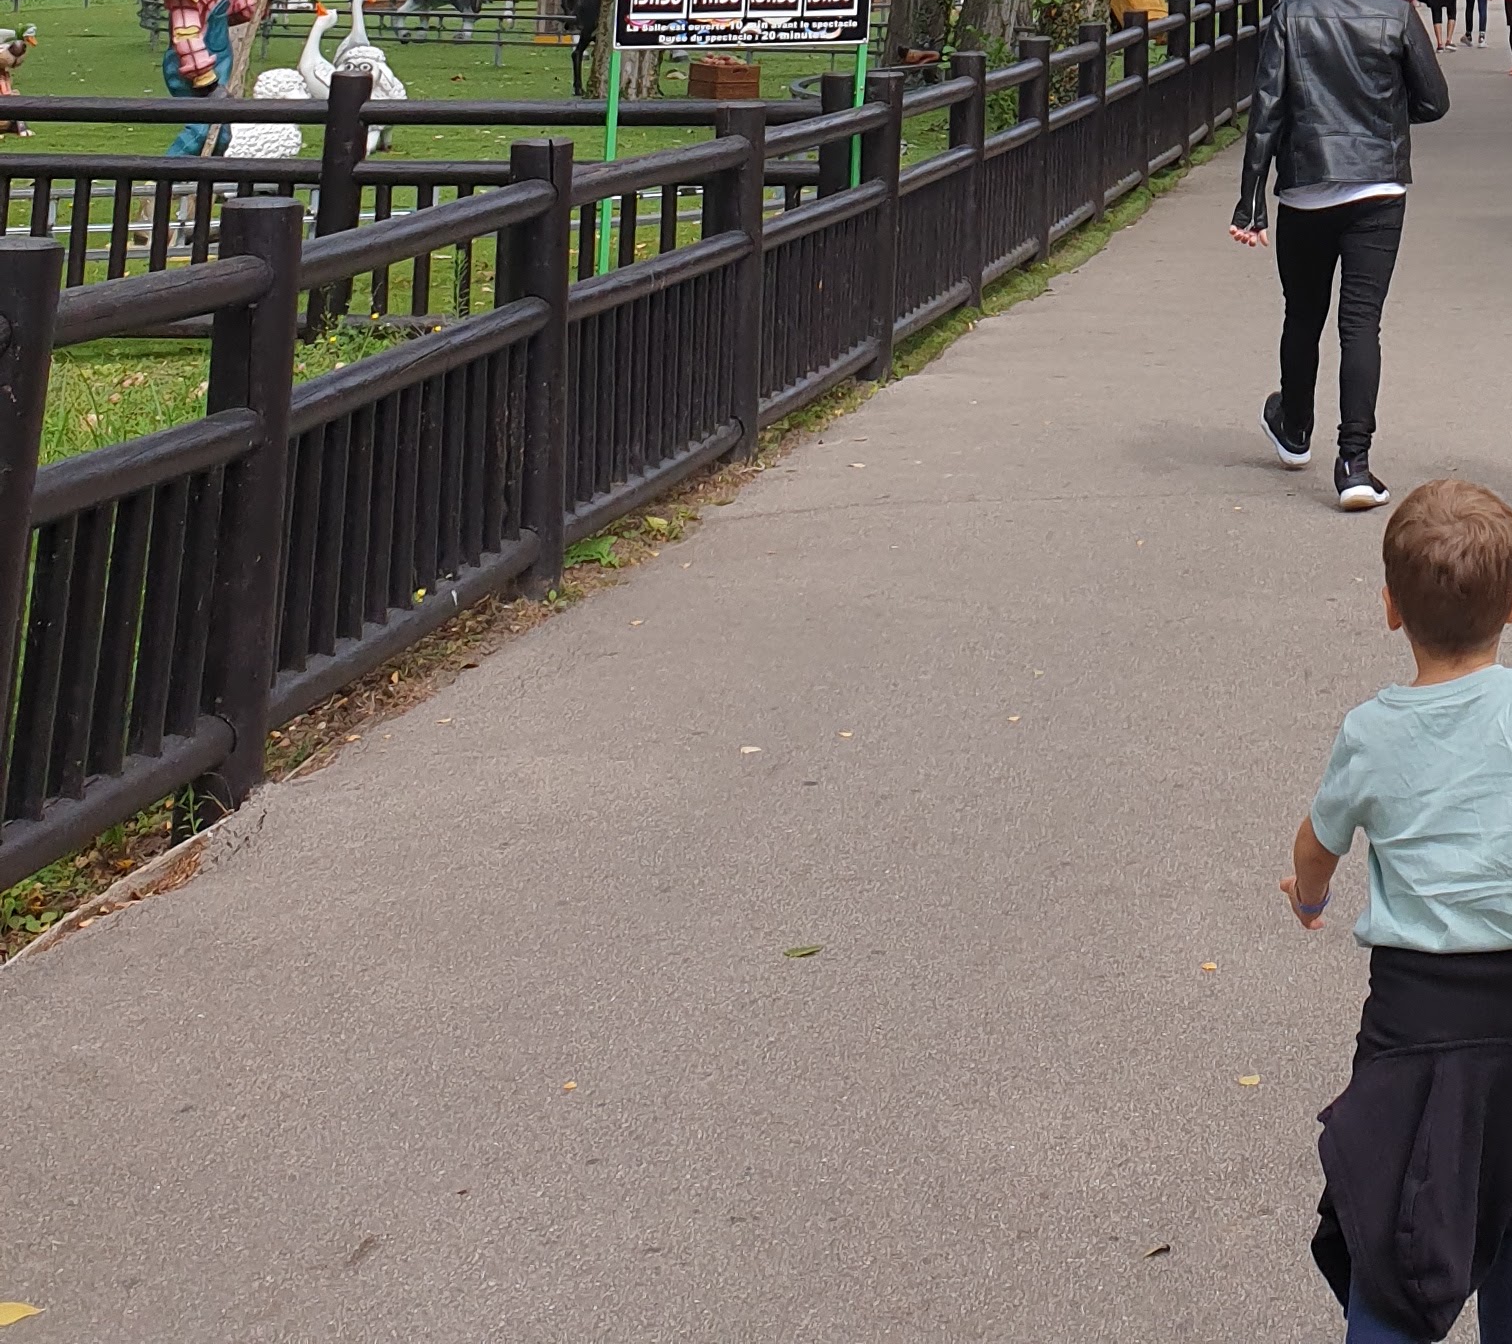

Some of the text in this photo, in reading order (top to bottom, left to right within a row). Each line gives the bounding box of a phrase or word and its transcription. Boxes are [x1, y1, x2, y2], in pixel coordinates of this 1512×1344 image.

[730, 20, 743, 30] 10
[771, 20, 798, 29] avant
[800, 20, 809, 28] le
[811, 19, 858, 30] spectacle
[690, 33, 703, 42] du
[705, 33, 753, 43] spectacle
[761, 31, 776, 40] 20
